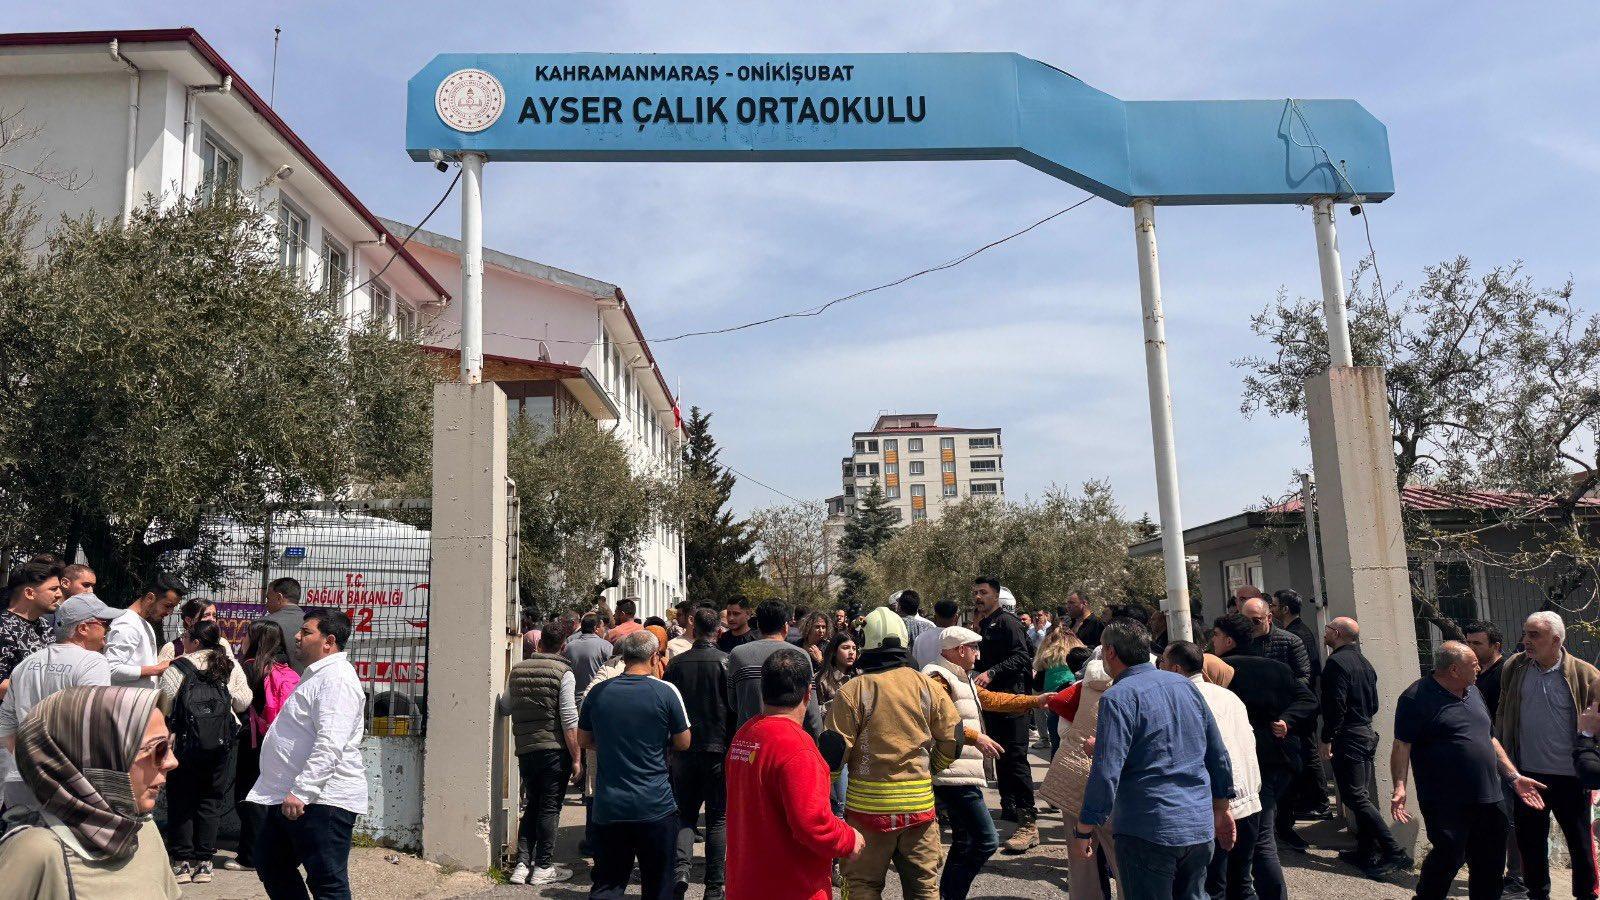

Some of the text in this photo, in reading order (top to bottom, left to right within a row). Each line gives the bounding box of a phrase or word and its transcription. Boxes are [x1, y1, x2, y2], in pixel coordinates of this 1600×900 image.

[535, 65, 719, 85] KAHRAMANMARAŞ
[737, 62, 854, 85] ONİKİŞUBAT
[519, 96, 623, 124] AYSER
[633, 96, 728, 132] ÇALIK
[736, 95, 926, 124] ORTAOKULU
[307, 587, 404, 606] SAĞLIK BAKANLIĞI
